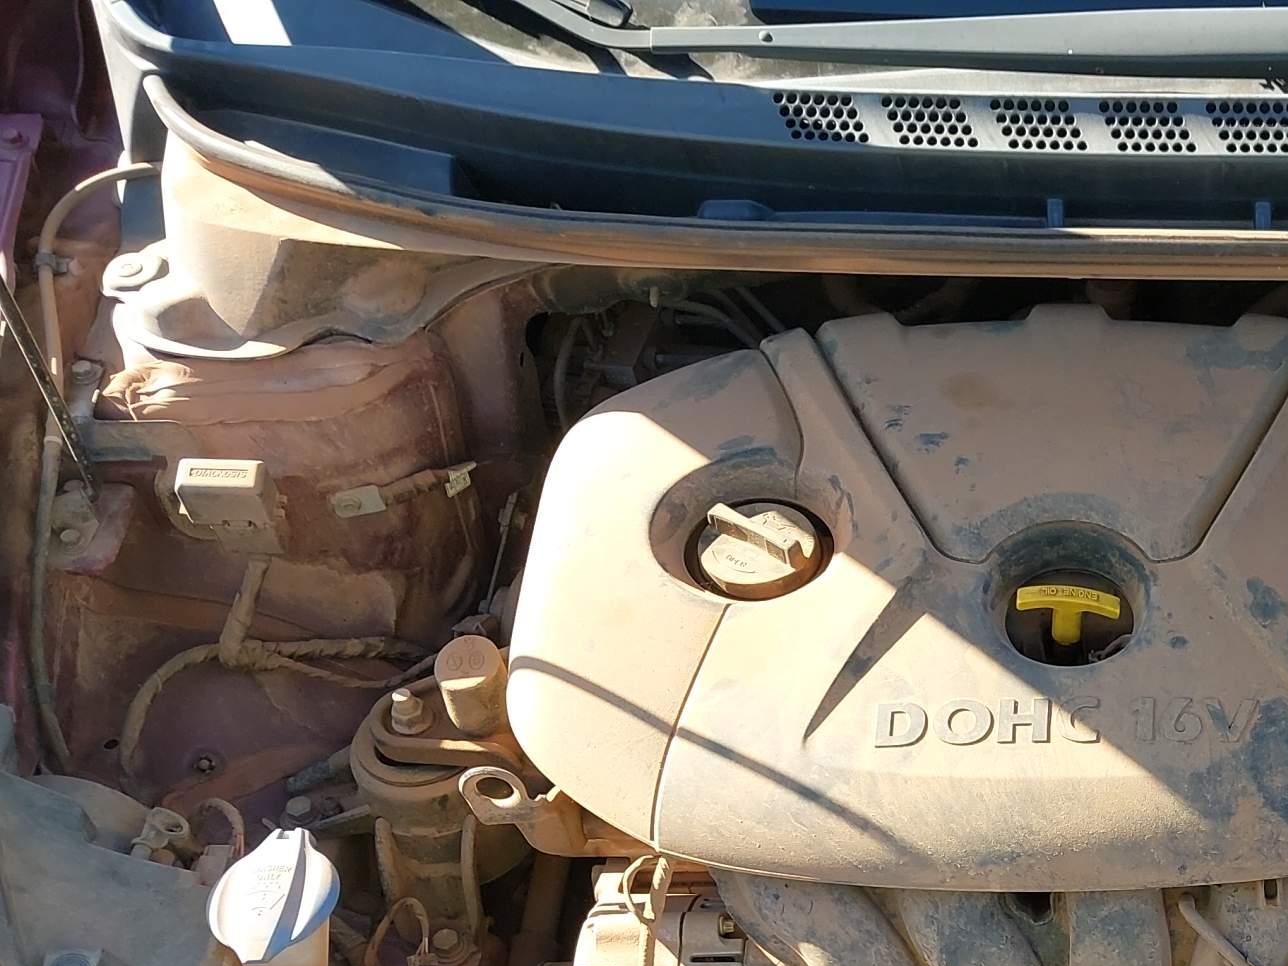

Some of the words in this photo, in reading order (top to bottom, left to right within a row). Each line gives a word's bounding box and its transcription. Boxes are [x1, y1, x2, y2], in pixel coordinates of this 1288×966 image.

[1041, 586, 1057, 596] OIL
[874, 696, 1101, 749] DOHC
[1132, 695, 1261, 746] 16V
